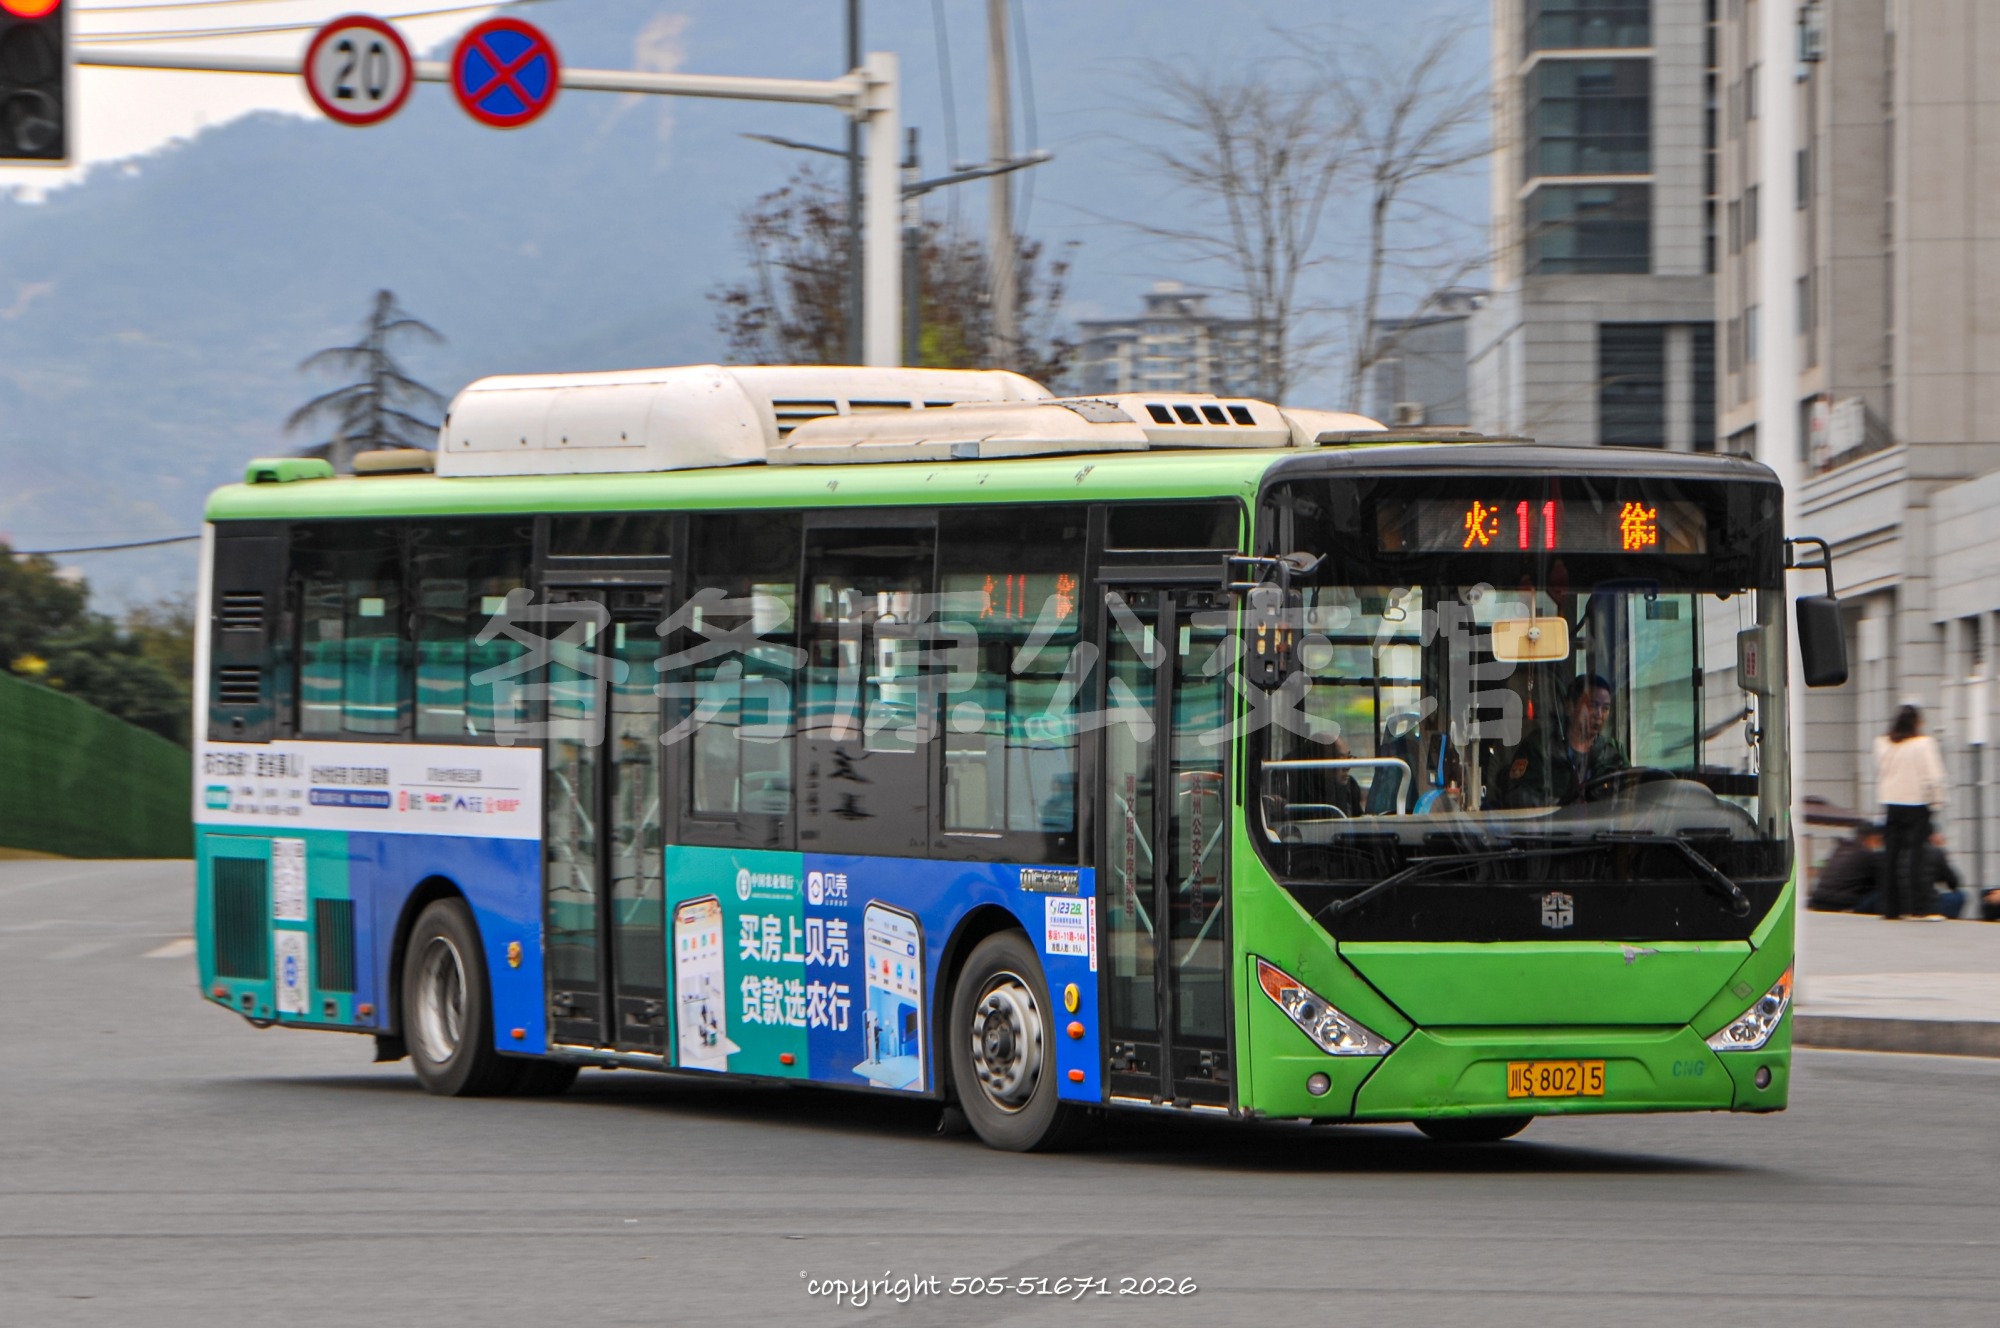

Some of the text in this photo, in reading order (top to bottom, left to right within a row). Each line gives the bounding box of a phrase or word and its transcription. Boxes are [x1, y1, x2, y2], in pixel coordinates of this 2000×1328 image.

[331, 38, 390, 101] 20
[1516, 500, 1556, 550] 11
[825, 873, 848, 898] 贝壳
[739, 914, 849, 967] 买房上贝壳
[740, 975, 851, 1032] 贷款选农行
[1672, 1060, 1705, 1077] CNG
